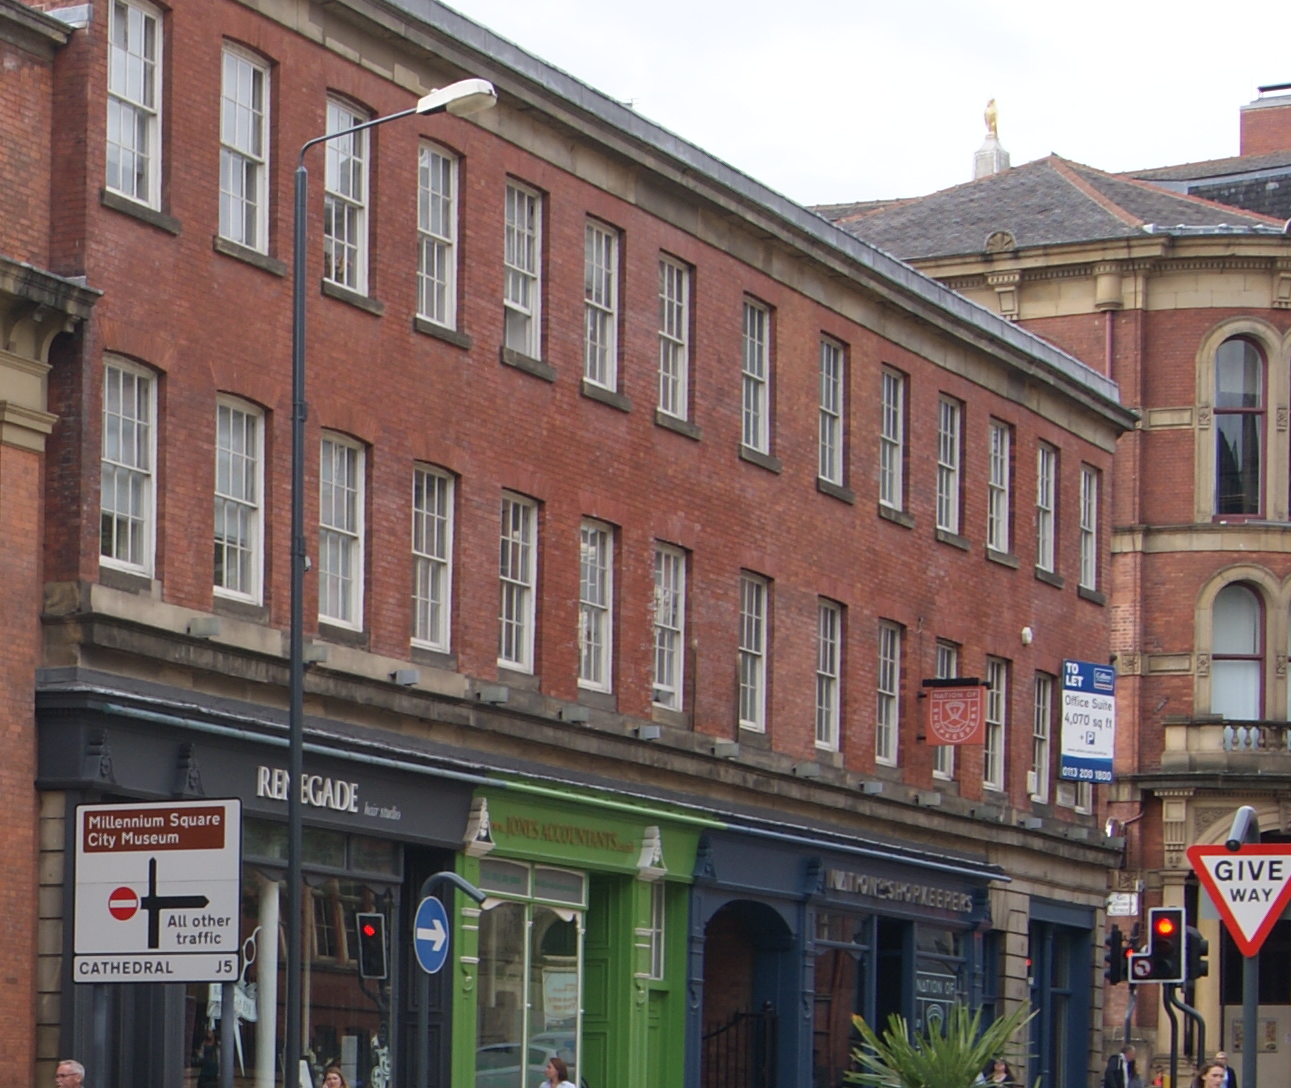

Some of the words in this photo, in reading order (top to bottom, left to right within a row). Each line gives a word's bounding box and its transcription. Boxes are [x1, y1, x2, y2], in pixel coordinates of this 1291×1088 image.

[1065, 662, 1079, 675] TO
[1065, 675, 1083, 688] LET
[1064, 694, 1089, 708] Office
[1091, 698, 1113, 712] Suite
[1064, 712, 1090, 726] 4,070
[1092, 718, 1103, 731] sq
[88, 815, 164, 830] Millennium
[169, 813, 221, 829] Square
[505, 816, 540, 839] JONES
[87, 832, 117, 849] City
[121, 832, 180, 846] Museum
[1214, 860, 1284, 881] GIVE
[1229, 888, 1273, 902] WAY
[167, 914, 187, 928] All
[192, 914, 231, 928] other
[176, 931, 222, 945] traffic
[79, 961, 174, 975] CATHEDRAL
[215, 960, 233, 974] J5
[916, 979, 943, 994] NATION
